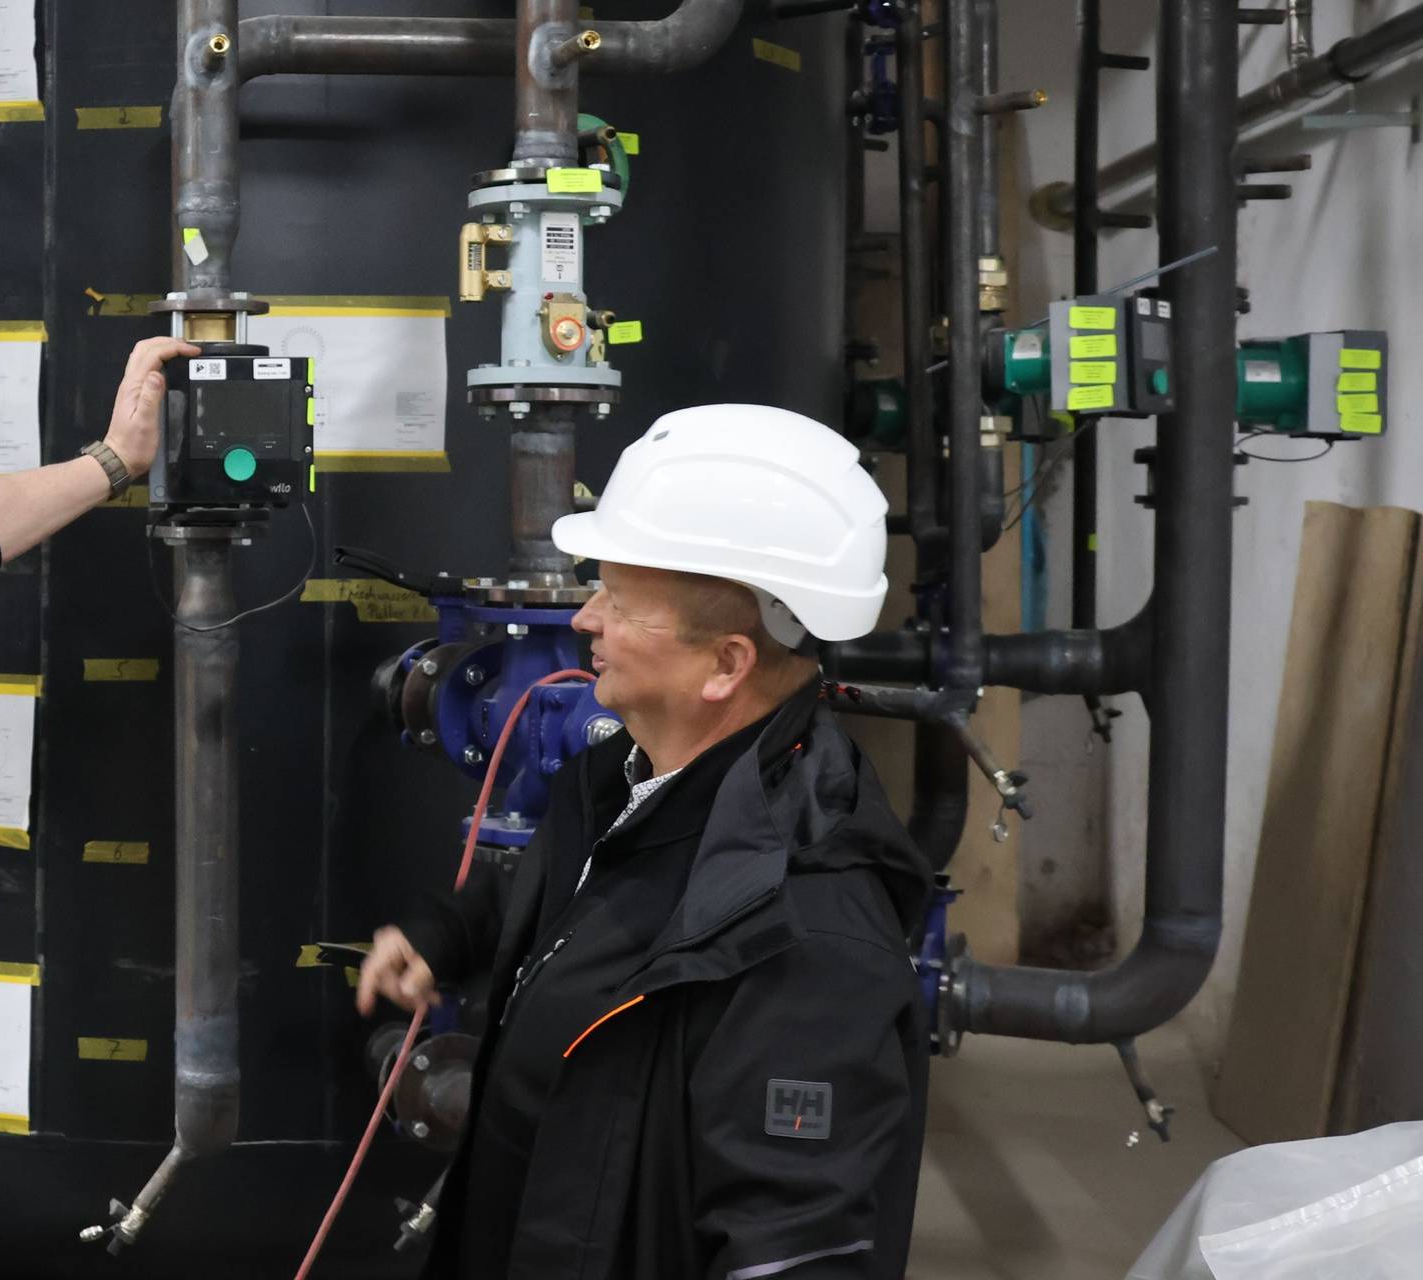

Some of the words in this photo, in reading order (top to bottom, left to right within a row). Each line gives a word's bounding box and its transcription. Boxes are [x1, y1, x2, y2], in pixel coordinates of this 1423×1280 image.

[119, 107, 130, 125] 2
[270, 482, 291, 493] wilo
[111, 660, 130, 678] 5
[114, 842, 122, 861] 6
[108, 1040, 122, 1059] 7
